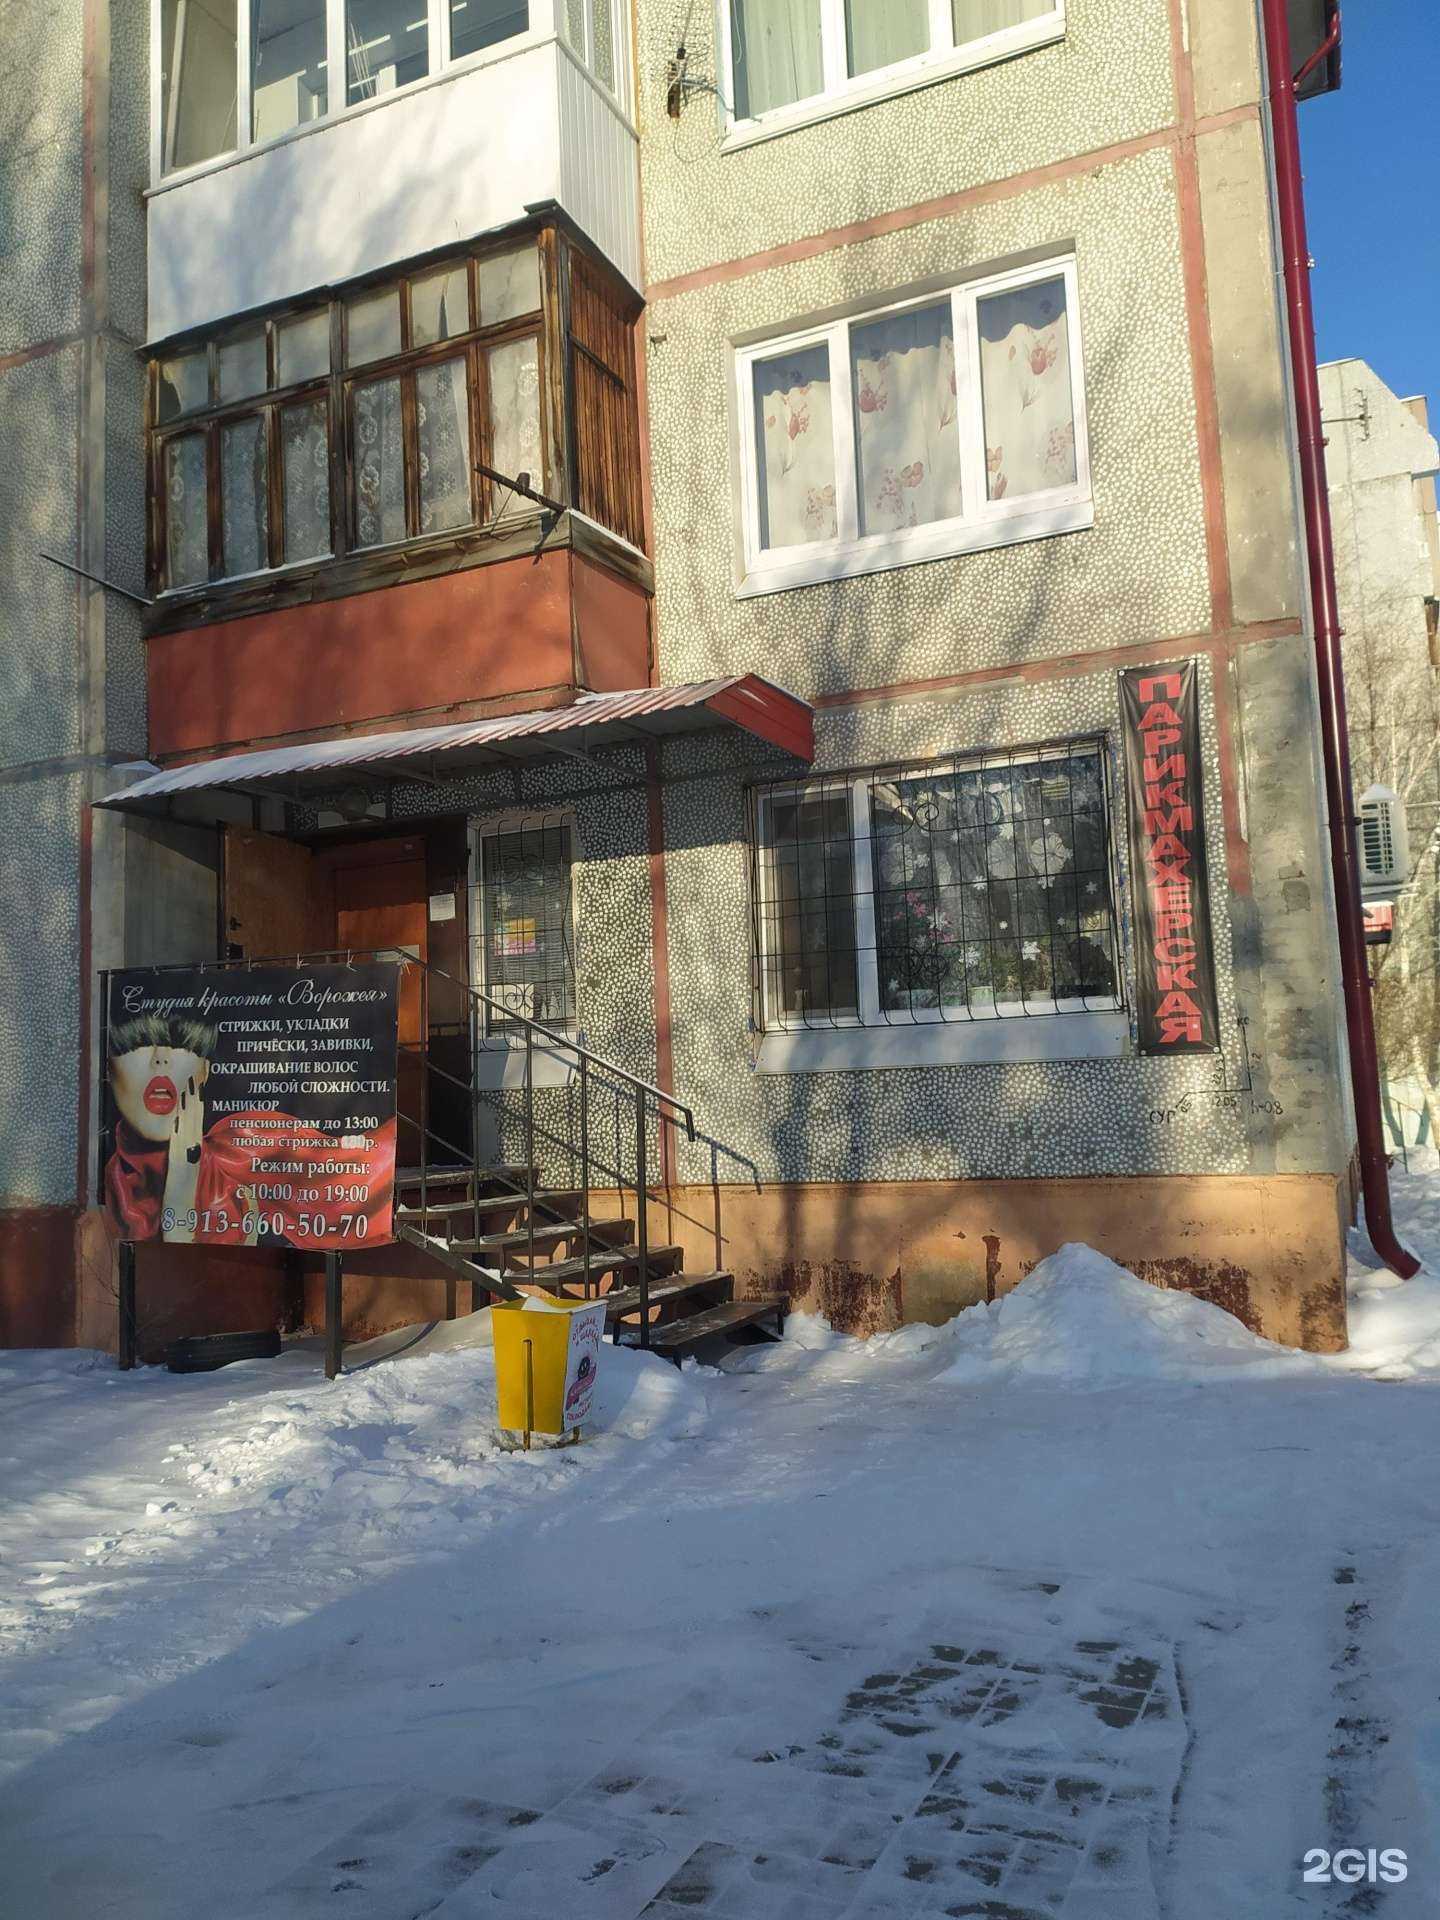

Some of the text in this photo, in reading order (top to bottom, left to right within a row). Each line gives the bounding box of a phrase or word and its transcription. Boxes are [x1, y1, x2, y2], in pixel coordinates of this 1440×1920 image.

[1137, 674, 1202, 1043] ПАРИКМАХЕРСКАЯ
[122, 979, 388, 1018] Студия красоты «Ворожея»
[218, 1018, 350, 1034] СТРИЖКИ, УКЛАДКИ
[237, 1037, 375, 1053] ПРИЧЁСКИ, ЗАВИВКИ,
[210, 1060, 359, 1075] ОКРАШИВАНИЕ ВОЛОС
[247, 1078, 391, 1094] ЛЮБОЙ СЛОЖНОСТИ.
[211, 1099, 280, 1113] МАНИКЮР
[229, 1116, 379, 1131] пенсионерам до 13:00
[231, 1136, 275, 1149] любая
[278, 1137, 339, 1150] стрижка
[250, 1157, 371, 1178] Режим работы:
[235, 1183, 369, 1203] с 10:00 до 19:00
[161, 1206, 369, 1240] 8-913-660-50-70
